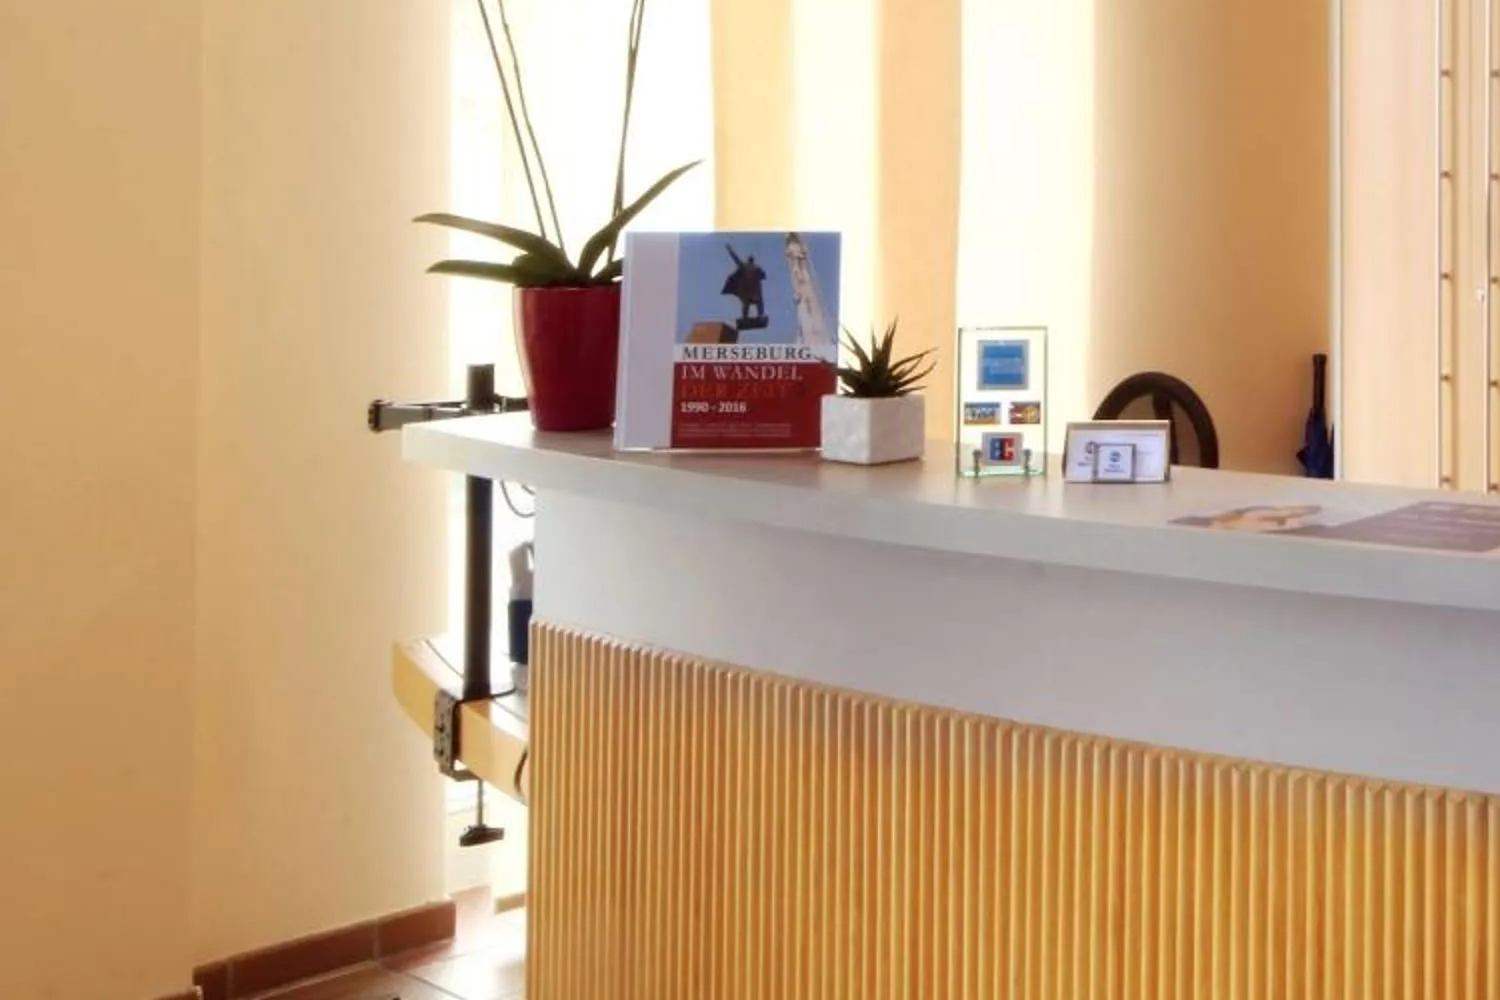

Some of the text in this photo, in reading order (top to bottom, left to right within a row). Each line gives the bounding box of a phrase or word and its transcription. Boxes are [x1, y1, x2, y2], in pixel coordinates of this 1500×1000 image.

[683, 346, 811, 360] MERSEBURG
[682, 365, 803, 381] IM WANDEL
[681, 401, 708, 413] 1990
